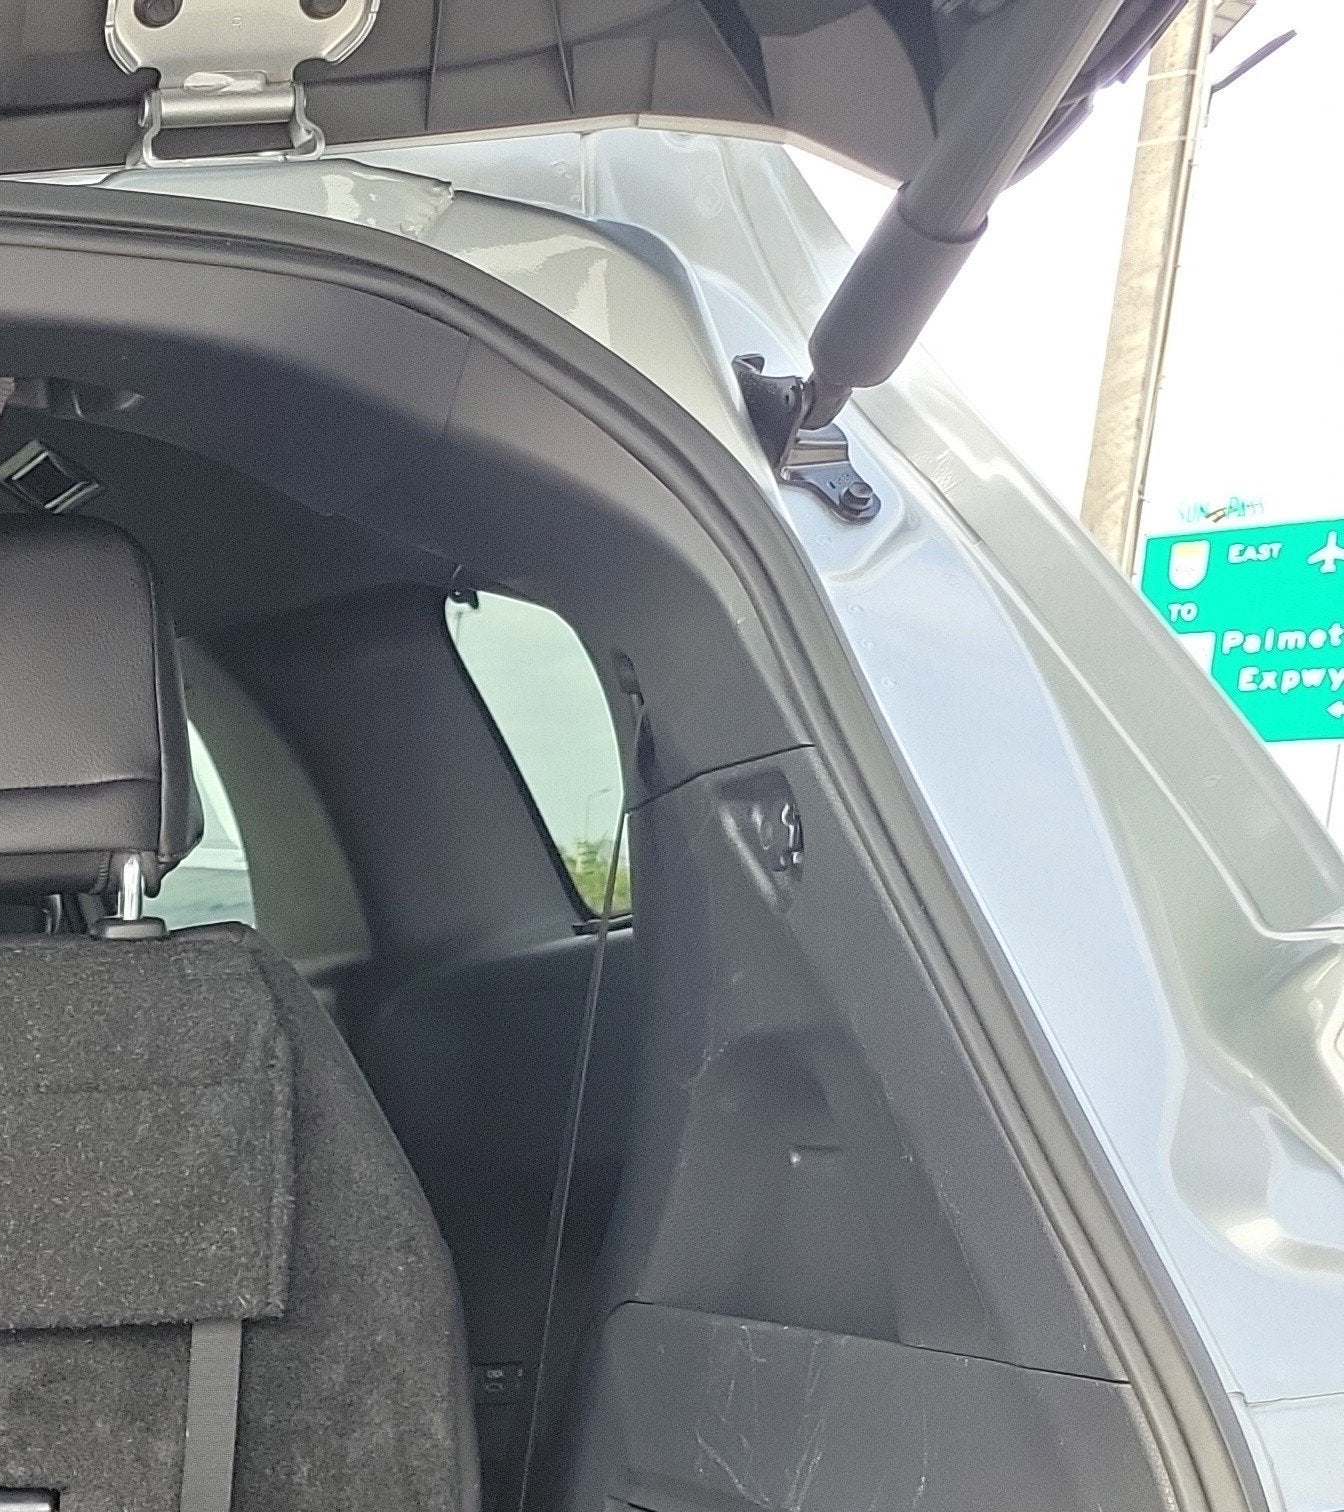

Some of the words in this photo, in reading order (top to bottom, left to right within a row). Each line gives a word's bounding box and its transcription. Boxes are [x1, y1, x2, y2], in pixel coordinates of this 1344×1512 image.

[1228, 542, 1283, 564] EAST
[1168, 602, 1199, 622] TO
[1237, 666, 1344, 694] Expwy
